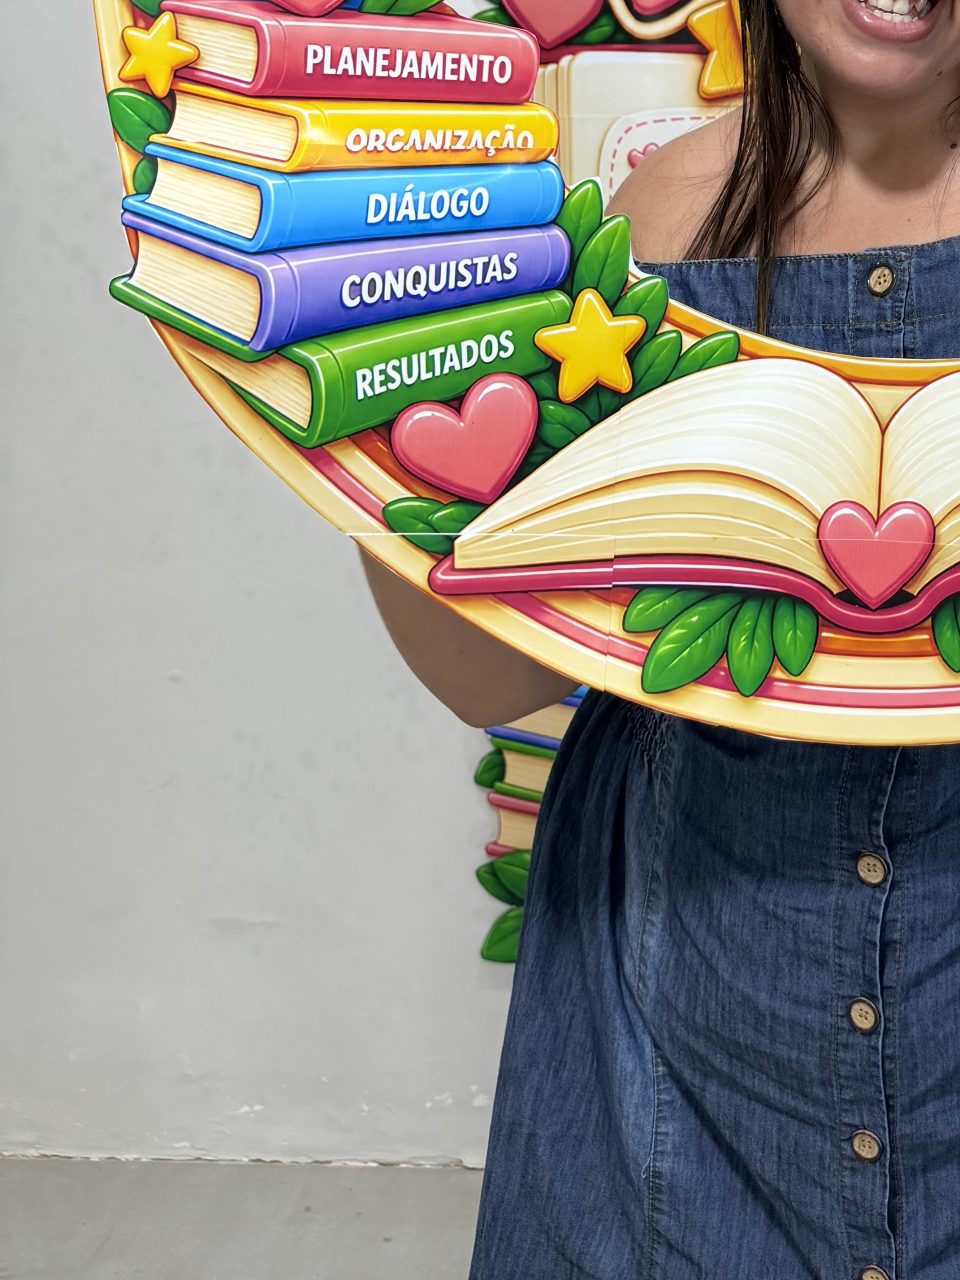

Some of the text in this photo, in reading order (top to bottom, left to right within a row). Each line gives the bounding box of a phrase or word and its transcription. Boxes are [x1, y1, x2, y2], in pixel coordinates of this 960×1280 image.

[305, 44, 513, 85] PLANEJAMENTO
[345, 123, 535, 157] ORGANIZAÇÃO
[366, 184, 490, 225] DIÁLOGO
[340, 252, 519, 309] CONQUISTAS
[355, 330, 515, 401] RESULTADOS
